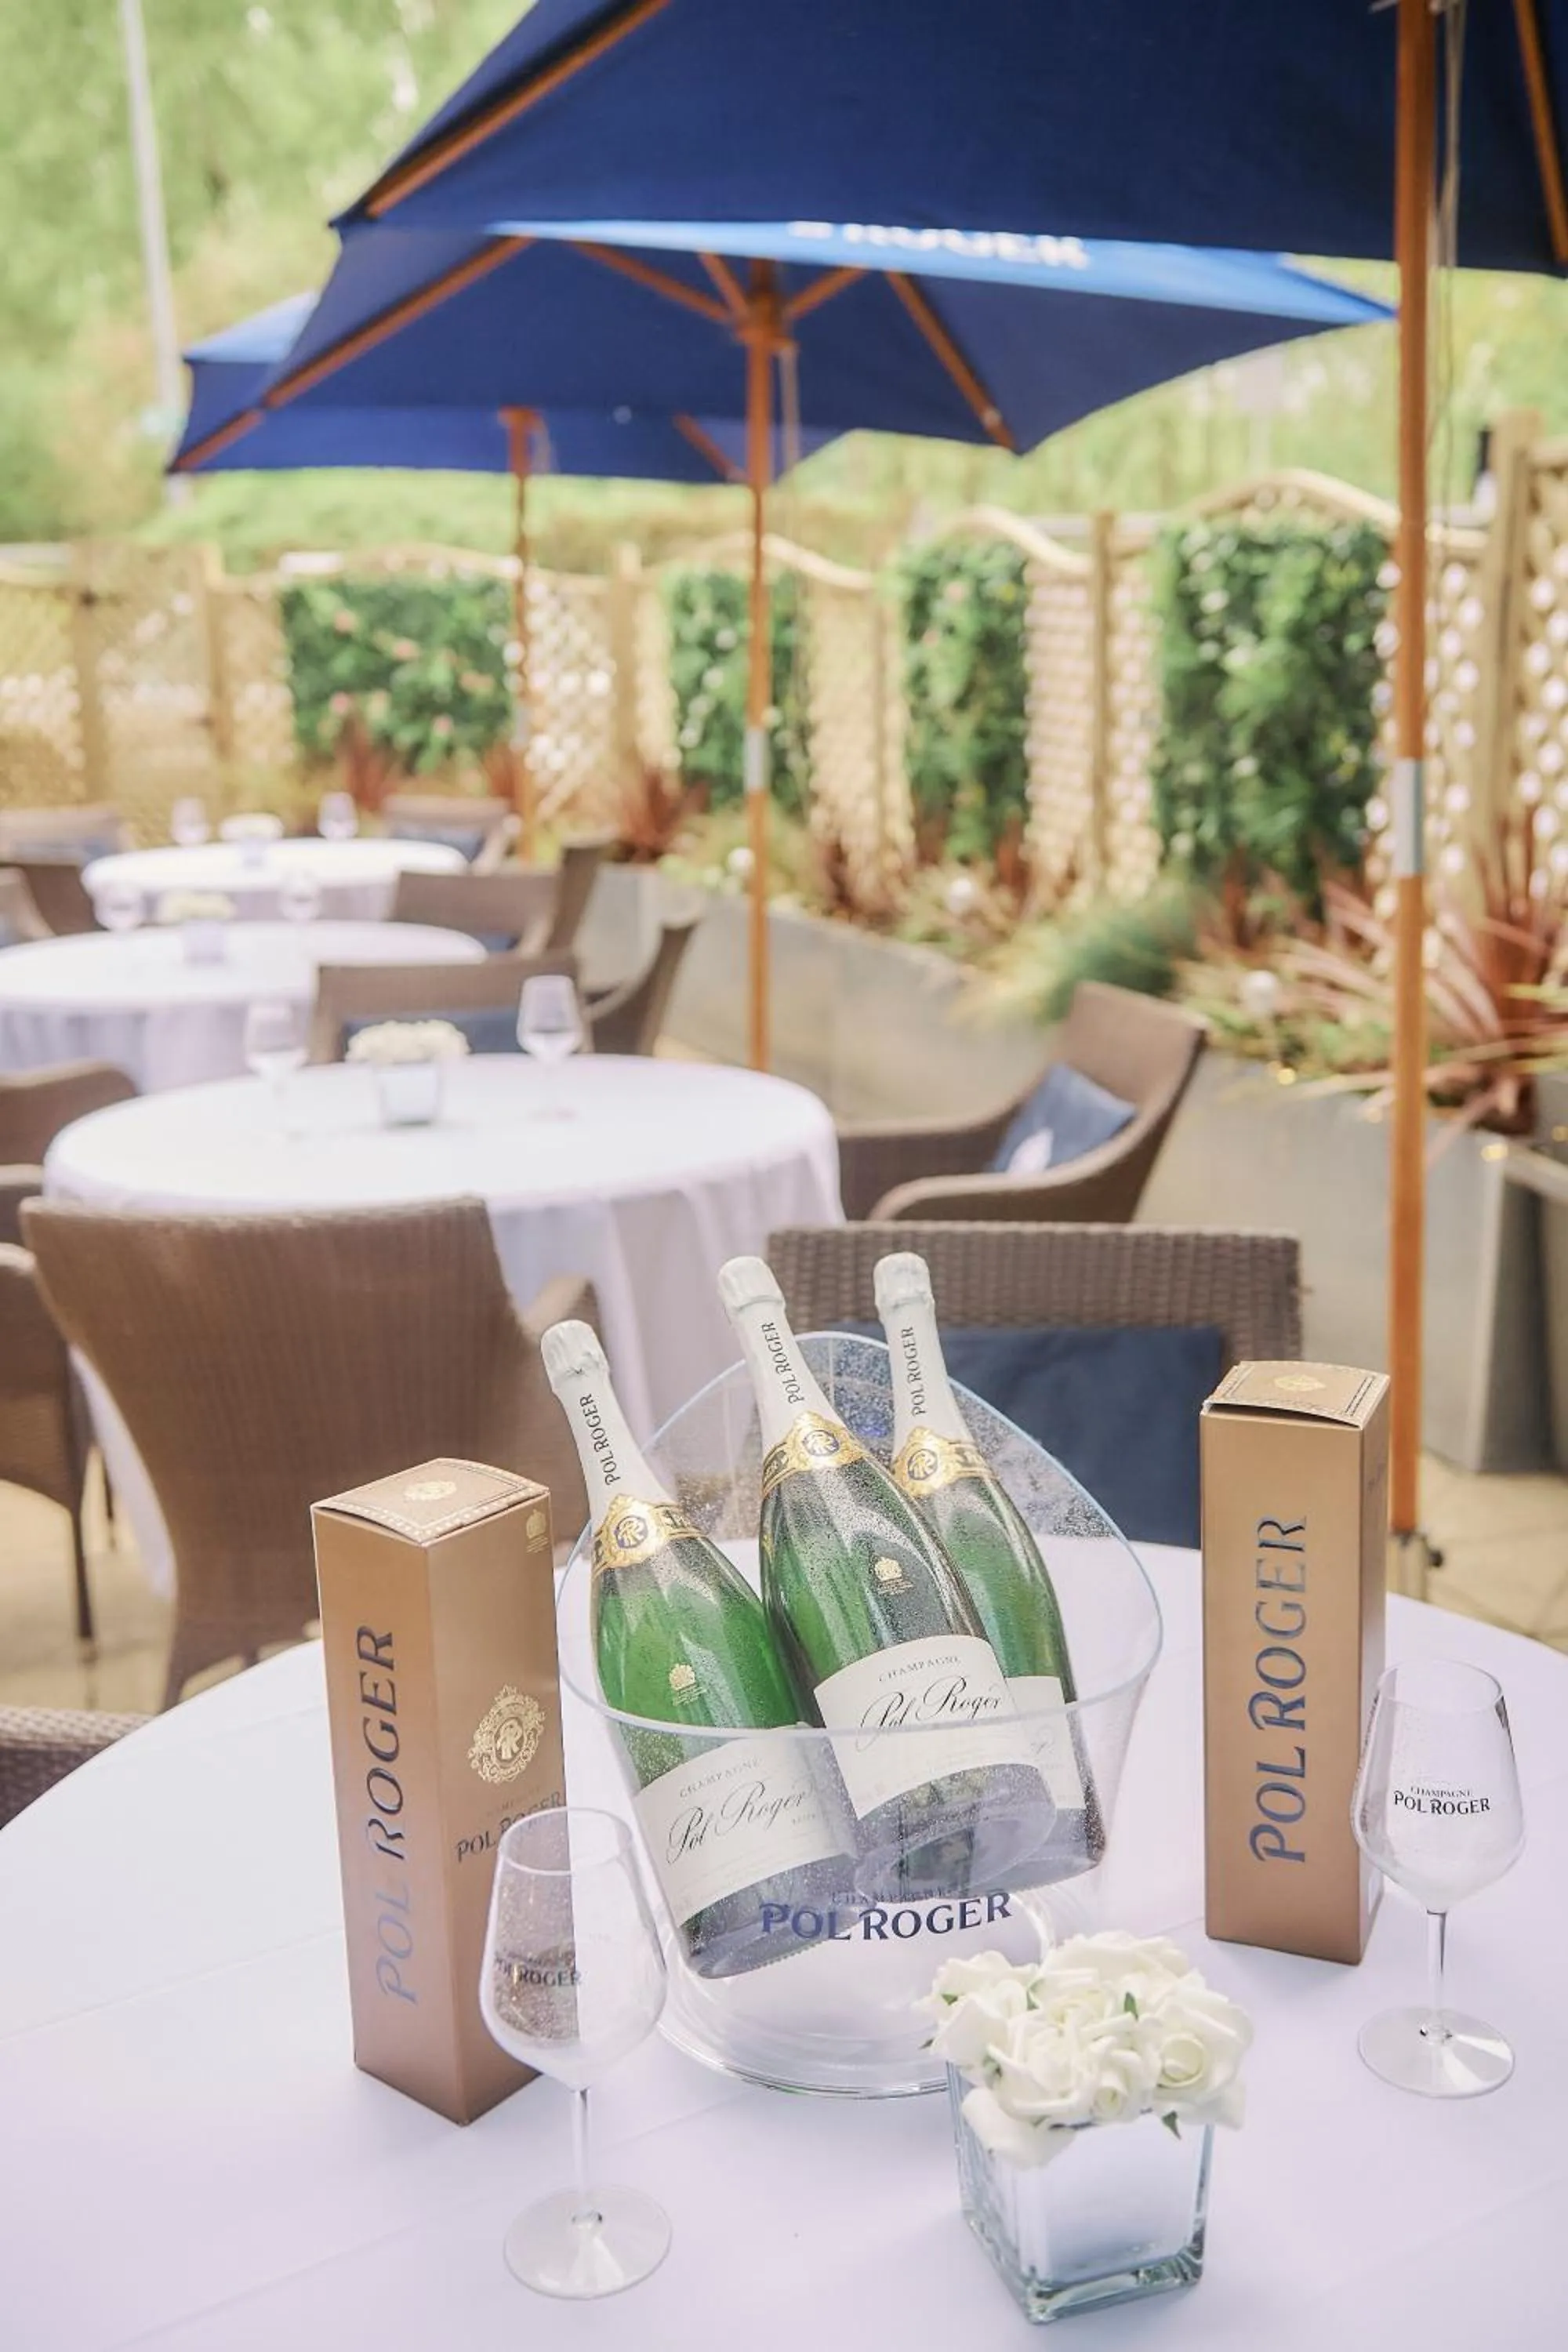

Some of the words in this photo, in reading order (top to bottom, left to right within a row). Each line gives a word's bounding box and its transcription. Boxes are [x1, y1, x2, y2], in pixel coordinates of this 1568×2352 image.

[761, 1322, 793, 1374] ROGER
[901, 1327, 922, 1384] ROGER
[782, 1374, 804, 1404] POL
[911, 1384, 927, 1417] POL
[579, 1393, 610, 1453] ROGER
[600, 1450, 621, 1486] POL
[1248, 1515, 1307, 1730] ROGER
[879, 1655, 962, 1682] CHAMPAGNE
[855, 1691, 916, 1753] Pol
[916, 1675, 1004, 1720] Roger
[356, 1625, 405, 1860] ROGER
[1250, 1746, 1306, 1862] POL
[1393, 1790, 1428, 1813] POL
[1429, 1798, 1490, 1815] ROGER
[1410, 1786, 1473, 1798] CHAMPAGNE
[666, 1806, 715, 1865] Pol
[714, 1774, 815, 1837] Roger
[455, 1831, 498, 1863] POL
[760, 1901, 851, 1940] POL
[858, 1889, 1013, 1940] ROGER
[376, 1883, 418, 2005] POL
